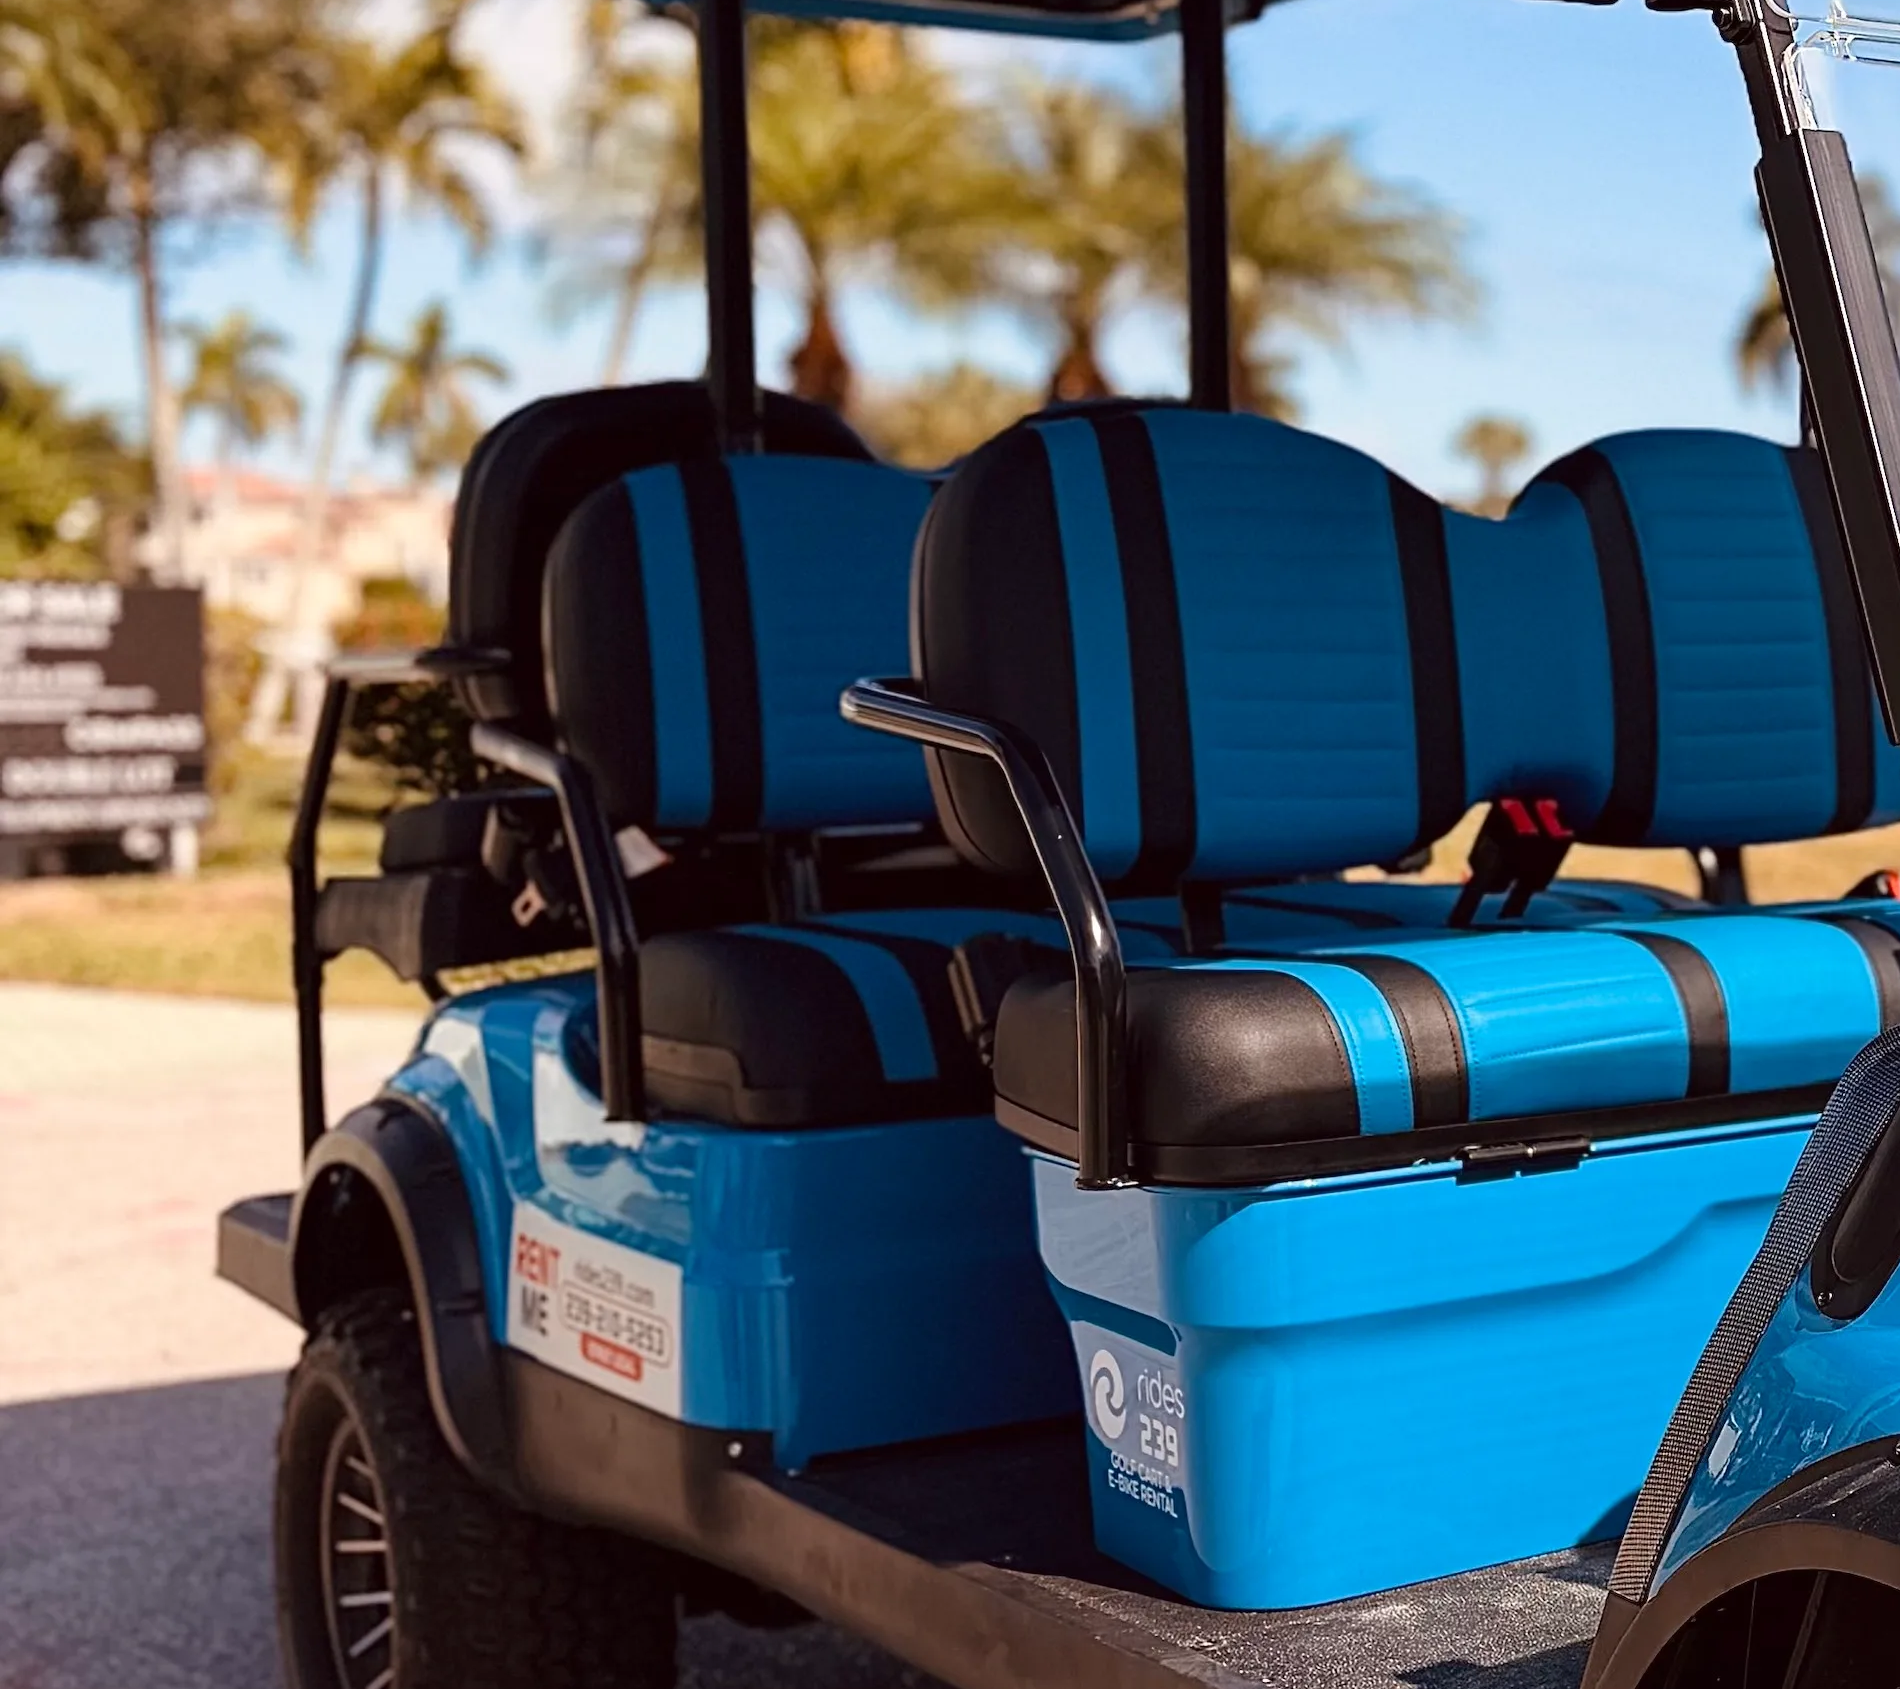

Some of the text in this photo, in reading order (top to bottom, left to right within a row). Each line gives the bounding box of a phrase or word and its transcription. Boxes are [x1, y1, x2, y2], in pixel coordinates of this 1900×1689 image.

[516, 1232, 561, 1289] RENT
[1137, 1368, 1185, 1419] rides
[1139, 1414, 1179, 1467] 239
[1108, 1468, 1178, 1518] E-BIKE RENTAL
[1111, 1451, 1136, 1476] GOLF
[1138, 1463, 1163, 1489] CART
